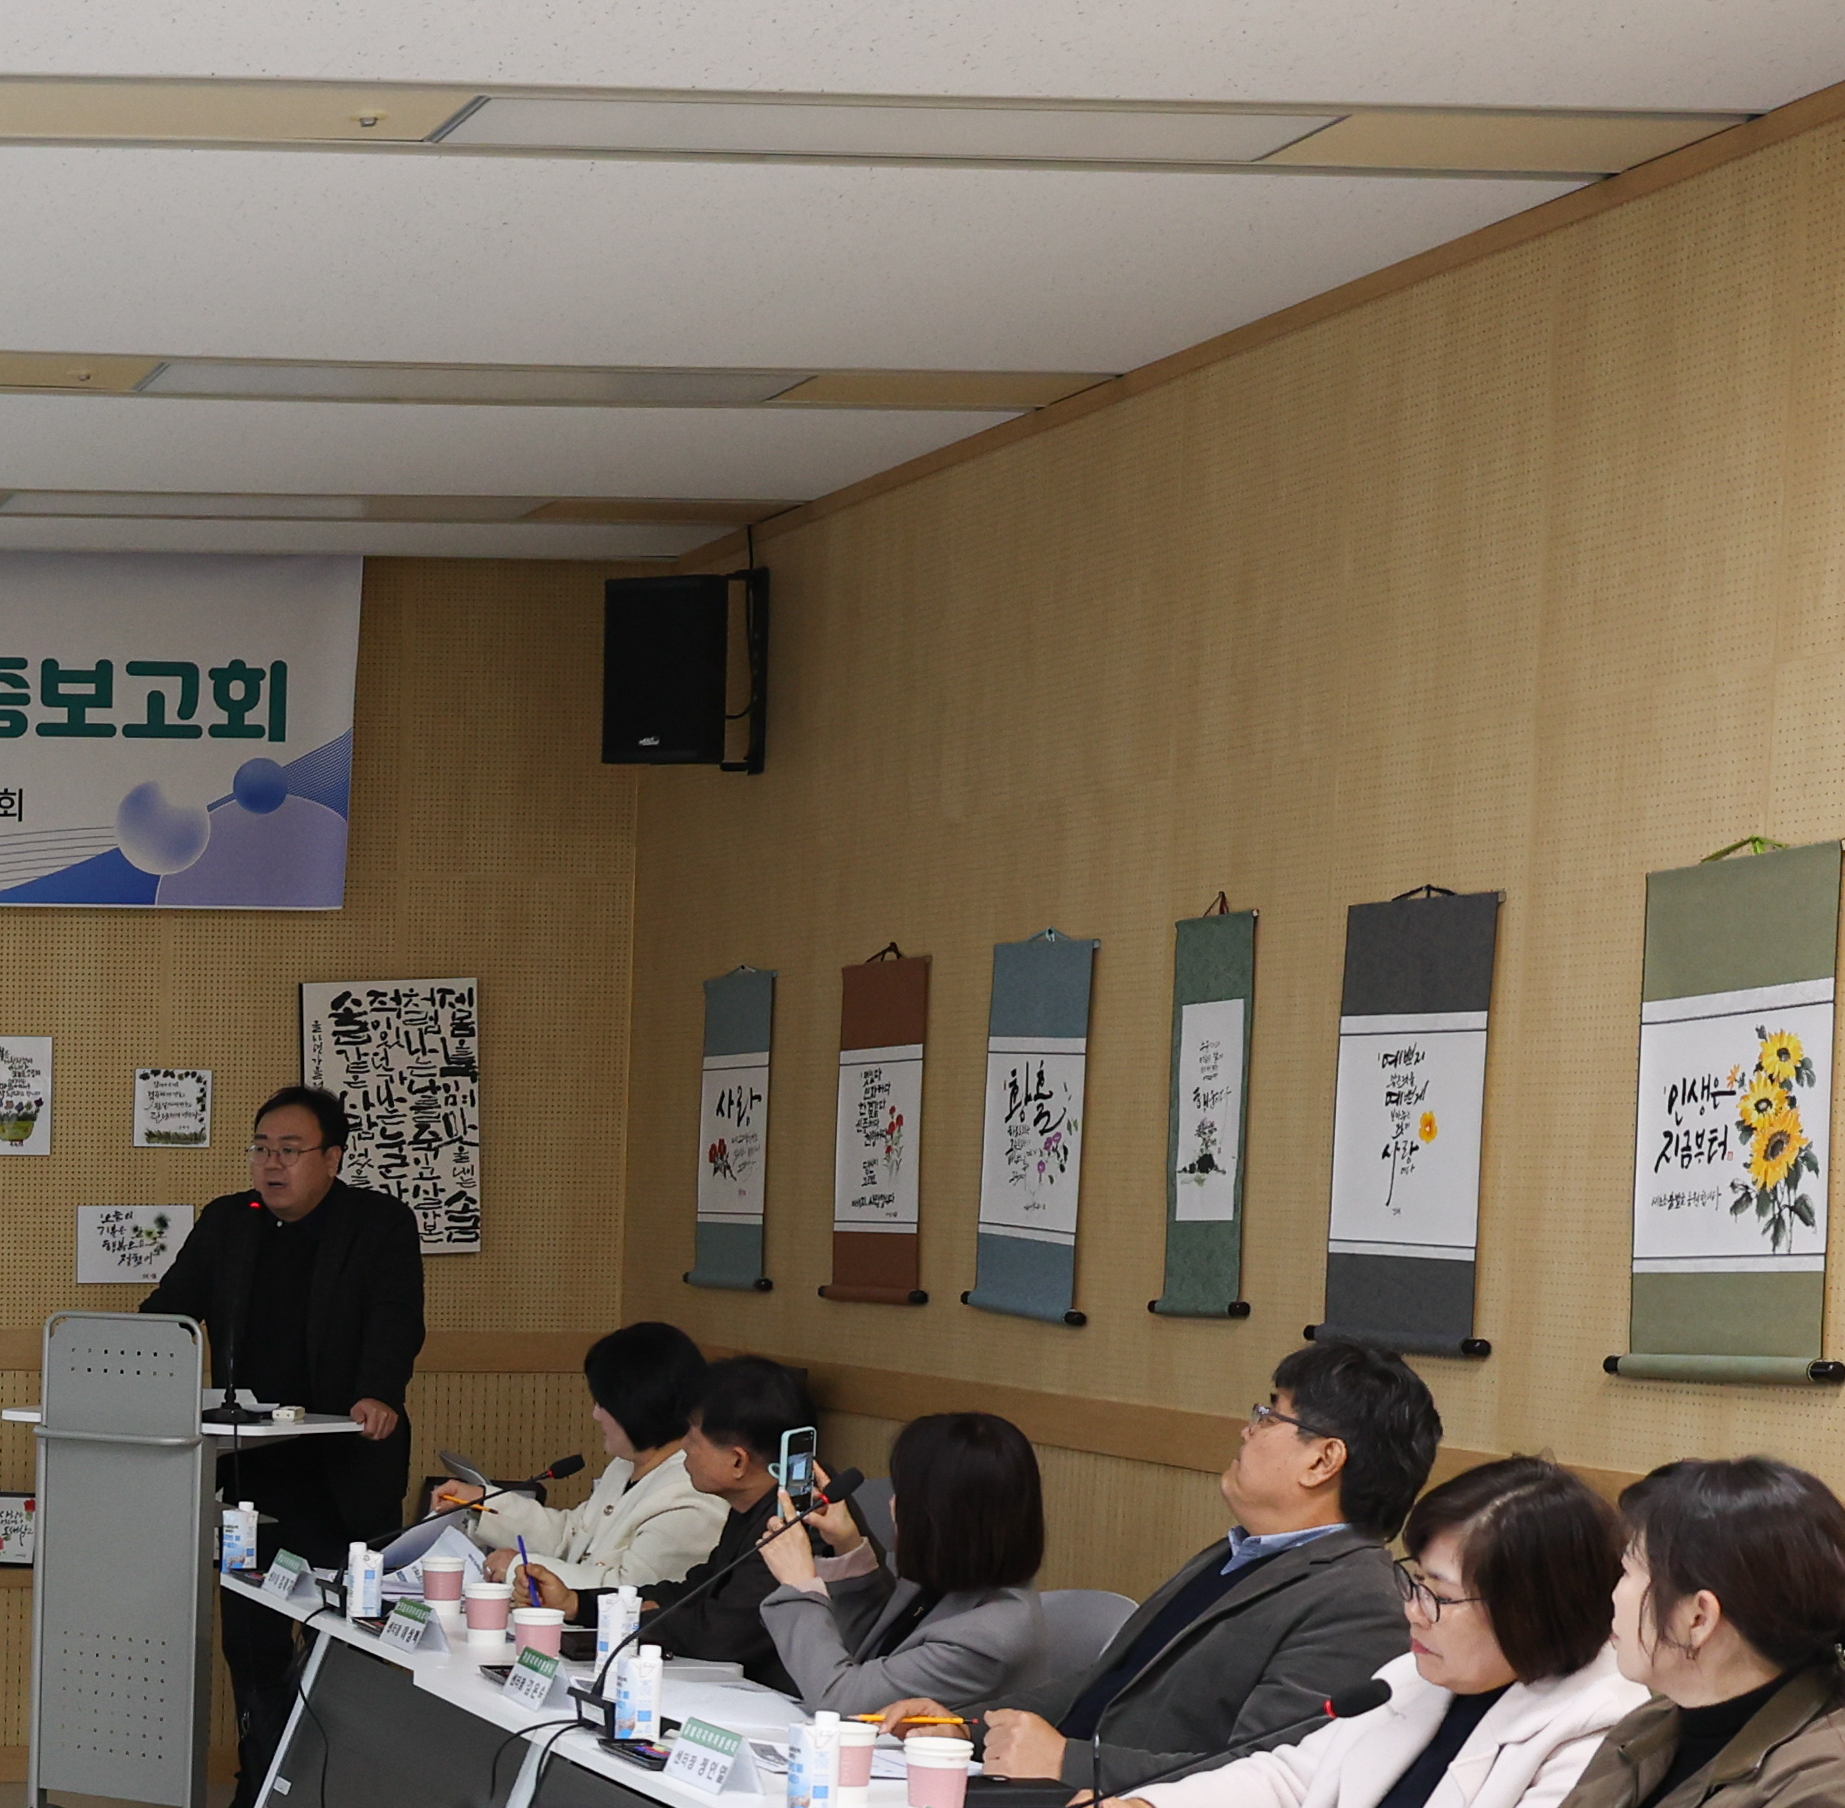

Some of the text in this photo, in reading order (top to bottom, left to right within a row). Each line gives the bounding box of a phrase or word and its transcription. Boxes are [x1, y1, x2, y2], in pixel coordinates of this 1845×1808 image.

[716, 1085, 762, 1127] 사랑
[1005, 1060, 1067, 1137] 황홀
[1668, 1073, 1736, 1126] 인생은
[1654, 1124, 1729, 1173] 지금부터
